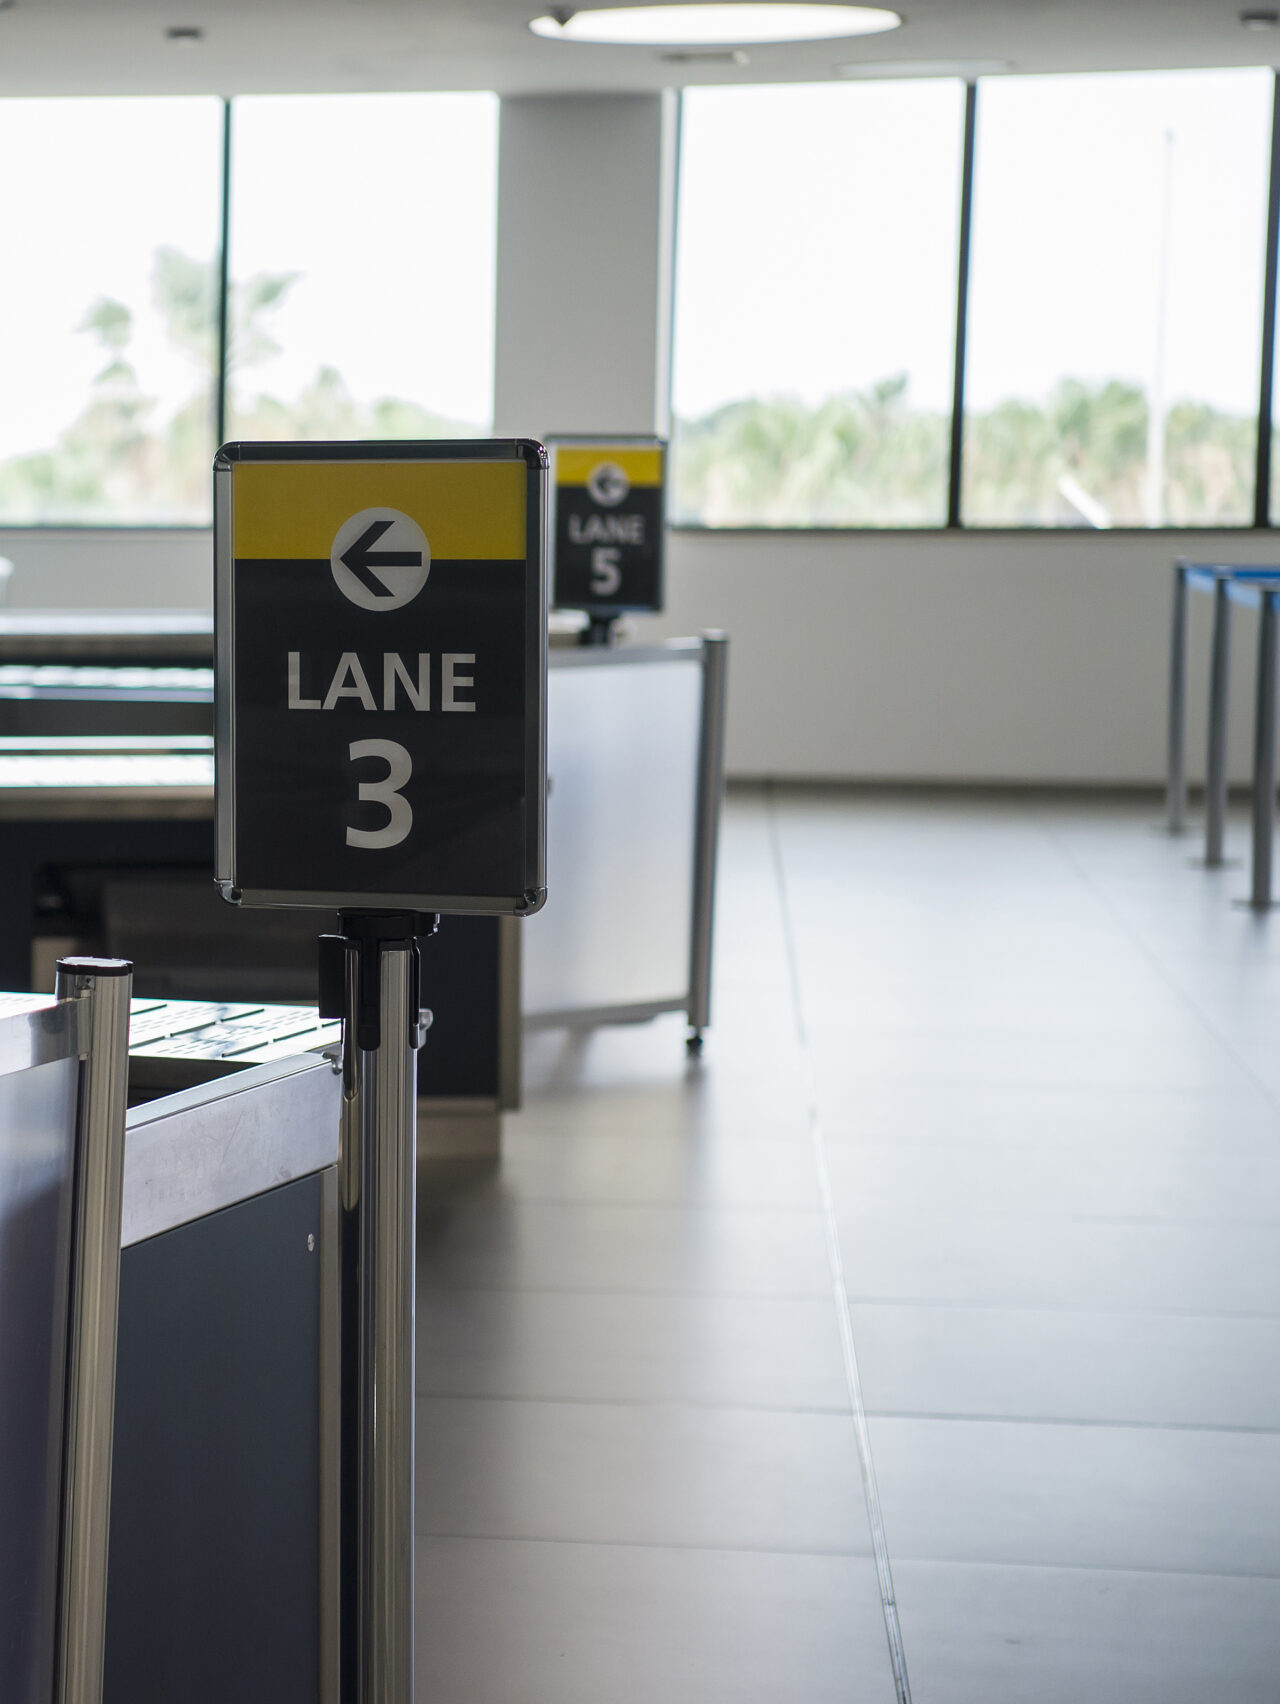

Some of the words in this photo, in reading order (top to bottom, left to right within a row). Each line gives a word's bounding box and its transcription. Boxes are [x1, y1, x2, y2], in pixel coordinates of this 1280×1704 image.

[568, 514, 645, 546] LANE
[589, 547, 623, 597] 5
[287, 651, 477, 712] LANE
[345, 738, 414, 850] 3
